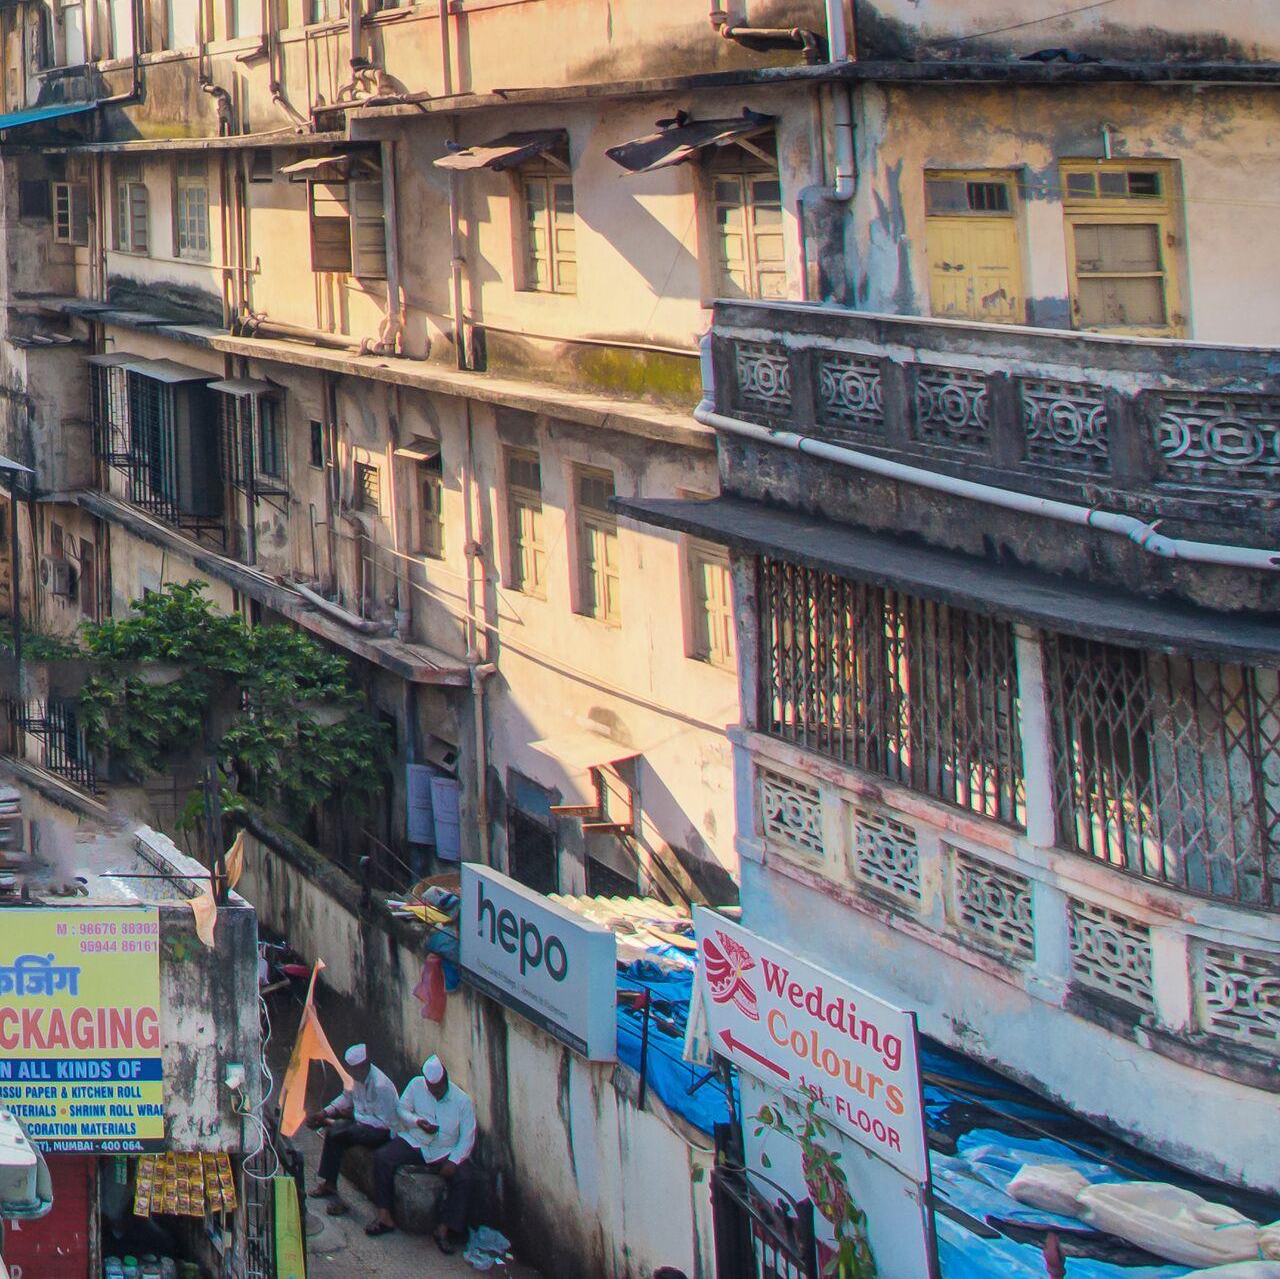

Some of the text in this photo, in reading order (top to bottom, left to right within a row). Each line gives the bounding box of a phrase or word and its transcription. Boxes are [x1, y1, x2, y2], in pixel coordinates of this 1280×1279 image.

[760, 956, 903, 1072] Wedding
[18, 1060, 51, 1079] ALL
[56, 1060, 112, 1079] KINDS
[117, 1060, 142, 1079] OF
[767, 1008, 906, 1116] Colours
[26, 1086, 57, 1099] PAPER
[60, 1086, 68, 1098] &
[71, 1086, 114, 1099] KITCHEN
[117, 1086, 142, 1099] ROLL
[69, 1104, 106, 1117] SHRINK
[110, 1104, 133, 1117] ROLL
[81, 1122, 137, 1135] MATERIALS
[836, 1096, 902, 1153] FLOOR
[53, 1141, 94, 1151] MUMBAI
[100, 1141, 120, 1151] 400
